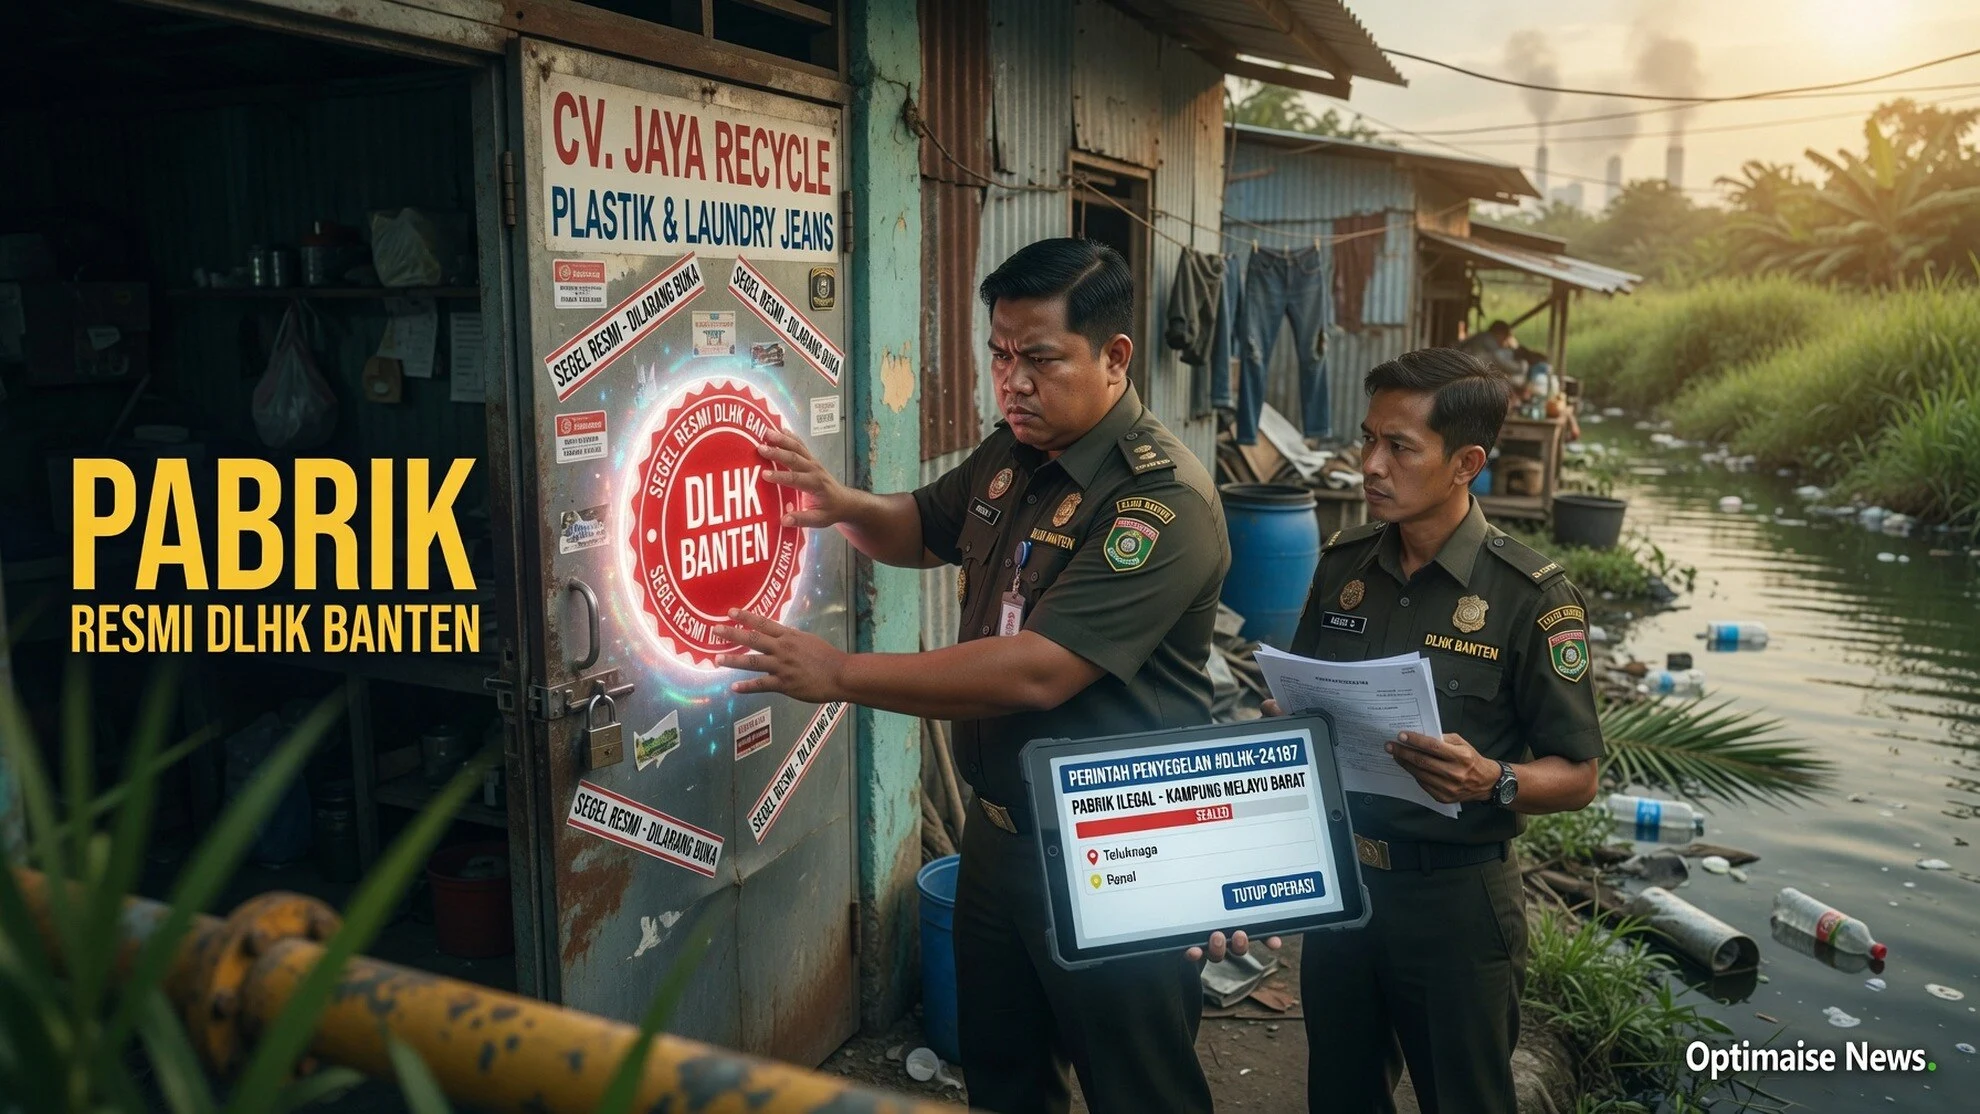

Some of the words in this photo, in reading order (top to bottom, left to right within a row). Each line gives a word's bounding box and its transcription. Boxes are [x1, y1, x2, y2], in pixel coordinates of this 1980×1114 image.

[553, 91, 613, 169] CV.
[625, 105, 706, 180] JAYA
[715, 120, 831, 195] RECYCLE
[552, 186, 656, 242] PLASTIK
[663, 196, 678, 243] &
[685, 199, 776, 248] LAUNDRY
[780, 209, 834, 252] JEANS
[553, 346, 591, 387] SEGEL
[587, 321, 623, 361] RESMI
[626, 281, 674, 332] DILARANG
[672, 263, 700, 297] BUKA
[649, 445, 679, 499] SEGEL
[673, 405, 712, 448] RESMI
[714, 403, 745, 426] DLHK
[685, 465, 763, 530] DLHK
[680, 521, 769, 581] BANTEN
[650, 564, 677, 615] SEGEL
[672, 605, 707, 643] RESMI
[1454, 639, 1499, 661] BANTEN
[1068, 763, 1130, 787] PERINTAH
[1132, 754, 1212, 780] PENYEGELAN
[1215, 744, 1298, 769] #DLHK-24187
[1072, 794, 1115, 815] PABRIK
[1165, 782, 1222, 804] KAMPUNG
[1223, 776, 1269, 797] MELAYU
[1270, 771, 1306, 791] BARAT
[574, 792, 608, 825] SEGEL
[608, 806, 643, 837] RESMI
[1231, 884, 1268, 904] TUTUP
[1269, 878, 1316, 898] OPERASI
